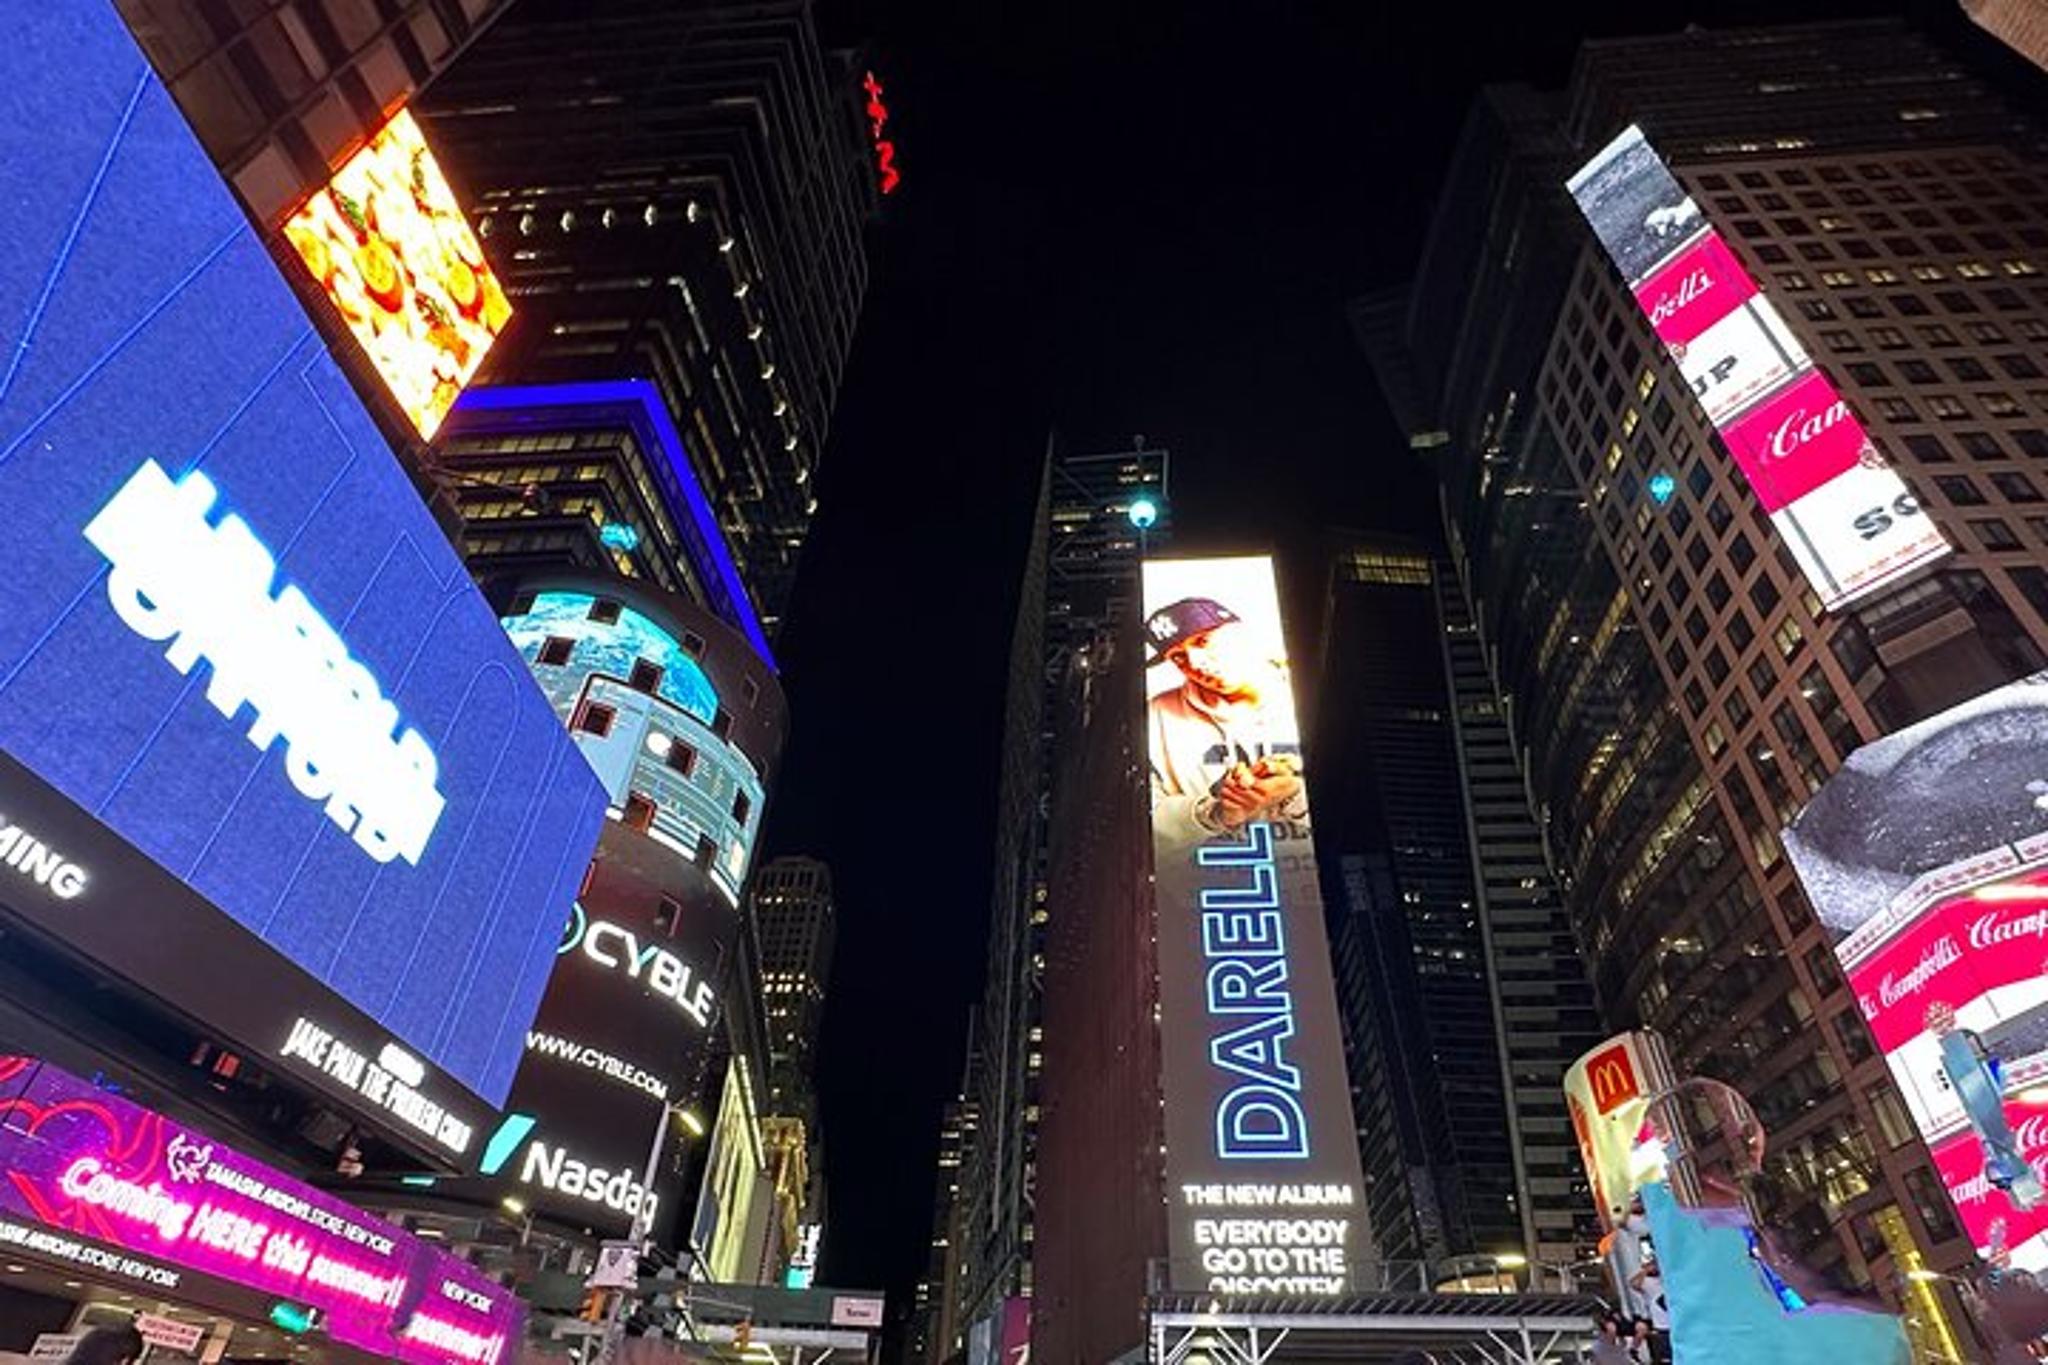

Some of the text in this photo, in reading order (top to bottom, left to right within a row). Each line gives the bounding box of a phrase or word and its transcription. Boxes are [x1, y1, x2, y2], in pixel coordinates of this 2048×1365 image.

[582, 920, 715, 1028] CYBLE
[1198, 821, 1310, 1159] DARELL
[280, 1017, 333, 1067] JAKE
[322, 1039, 367, 1090] PAUL
[58, 1157, 192, 1241] Coming
[188, 1202, 267, 1259] HERE
[263, 1232, 312, 1276] this
[520, 1140, 659, 1235] Nasdaq
[1182, 1184, 1353, 1205] THE NEW ALBUM
[1194, 1219, 1348, 1245] EVERYBODY
[1202, 1247, 1346, 1274] GO TO THE
